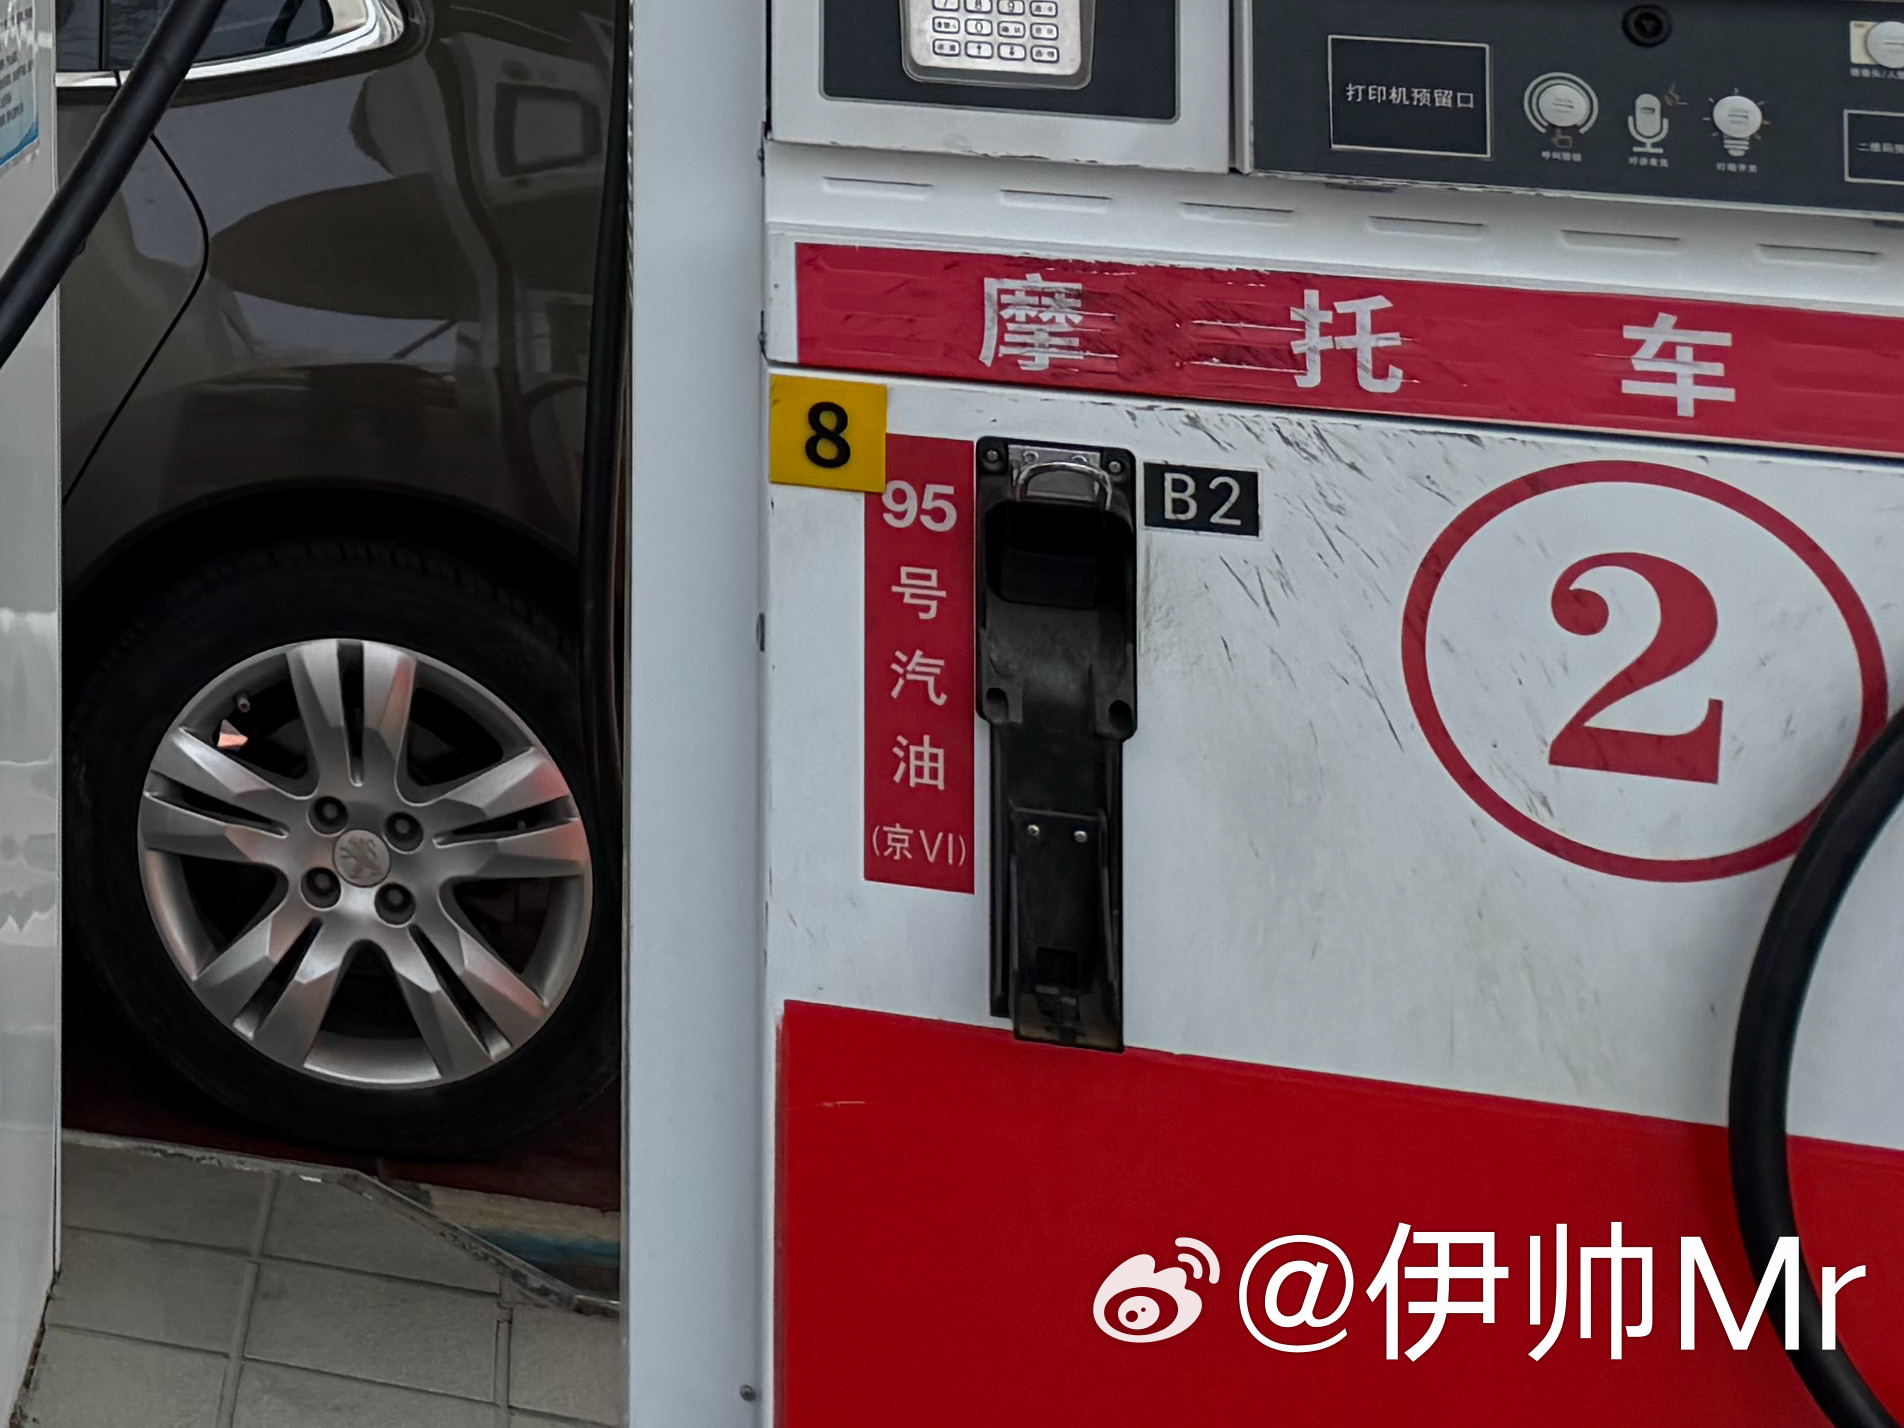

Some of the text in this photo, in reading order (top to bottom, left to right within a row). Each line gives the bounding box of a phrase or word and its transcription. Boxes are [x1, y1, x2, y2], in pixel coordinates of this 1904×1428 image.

[1346, 83, 1474, 108] 打印机预留口
[979, 272, 1736, 417] 摩托车
[804, 401, 852, 467] 8
[1162, 476, 1243, 526] B2
[1547, 552, 1724, 784] 2
